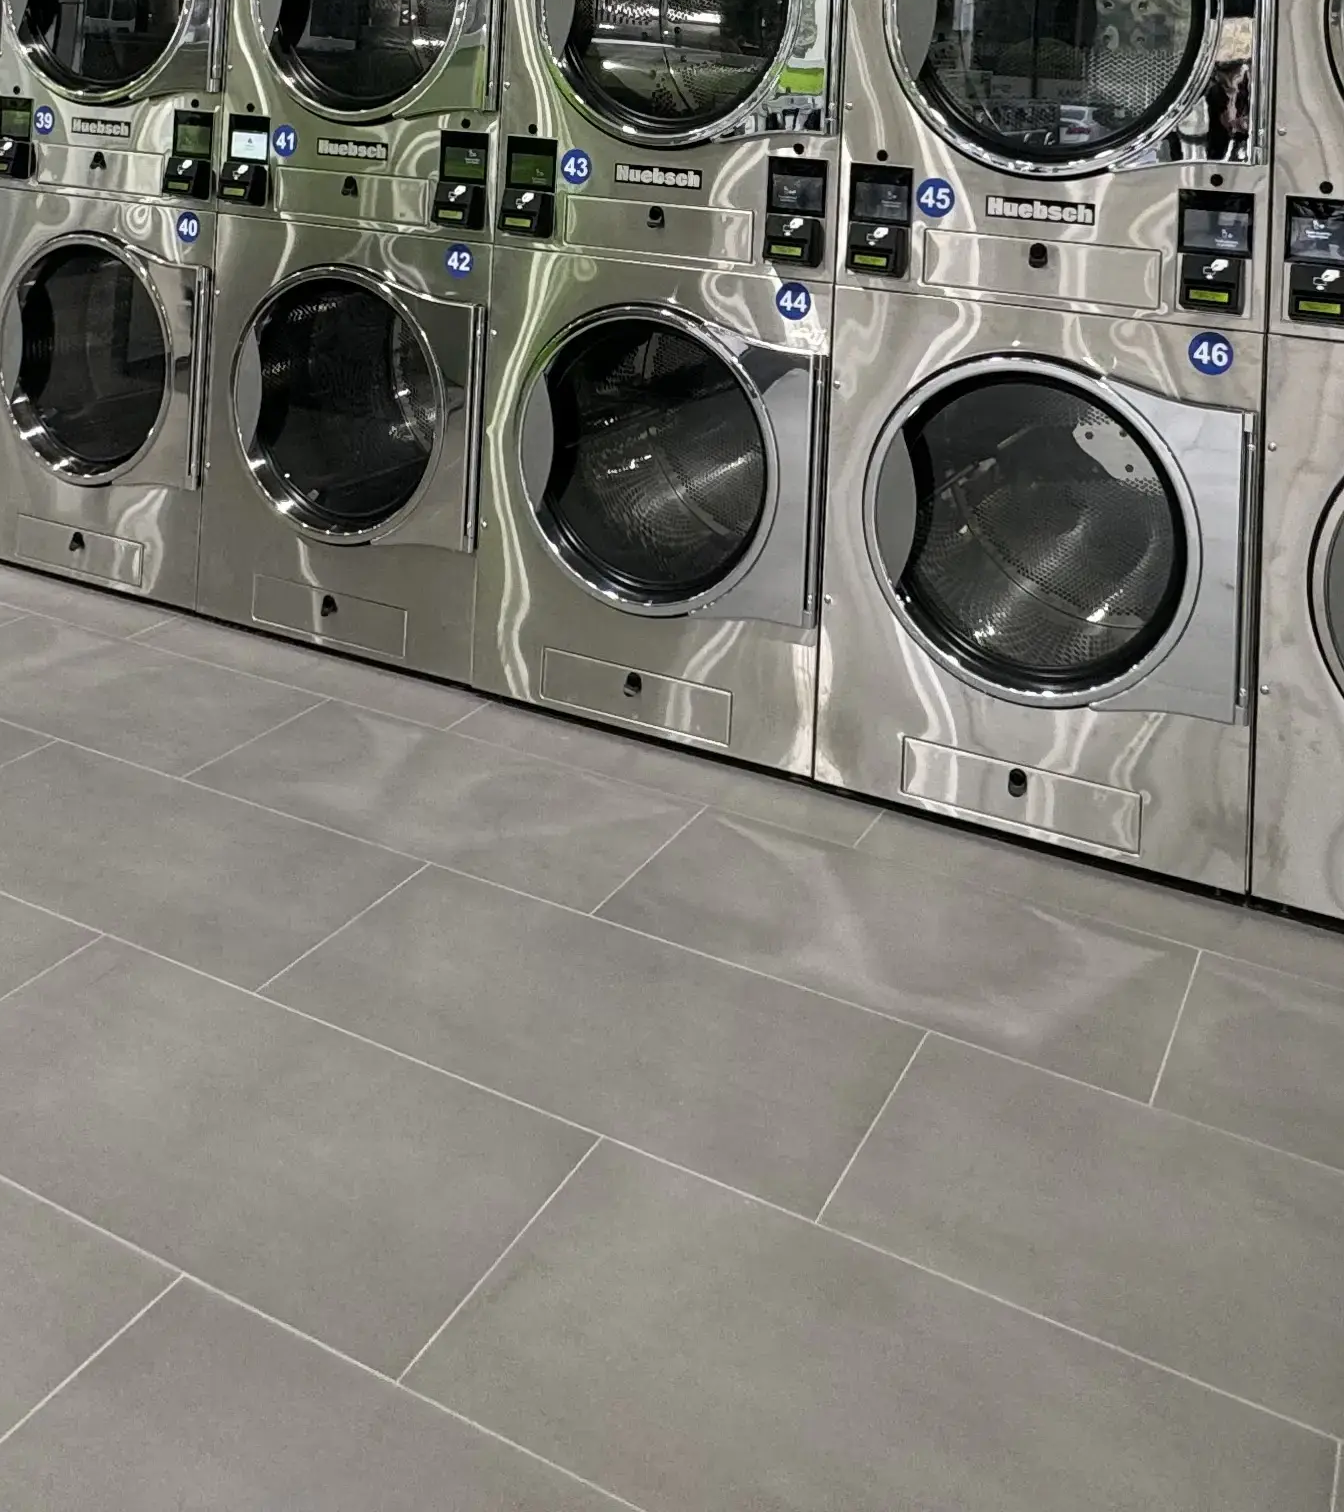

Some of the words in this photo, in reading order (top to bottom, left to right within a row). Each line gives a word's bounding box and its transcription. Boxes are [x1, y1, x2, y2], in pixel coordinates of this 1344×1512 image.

[35, 111, 53, 130] 39
[275, 131, 295, 151] 41
[318, 138, 387, 160] Huebsch
[563, 156, 589, 177] 43
[616, 164, 701, 188] Huebsch
[920, 186, 951, 209] 45
[987, 196, 1094, 224] Huebsch
[178, 218, 198, 237] 40
[447, 251, 471, 272] 42
[779, 290, 808, 313] 44
[1193, 341, 1229, 367] 46
